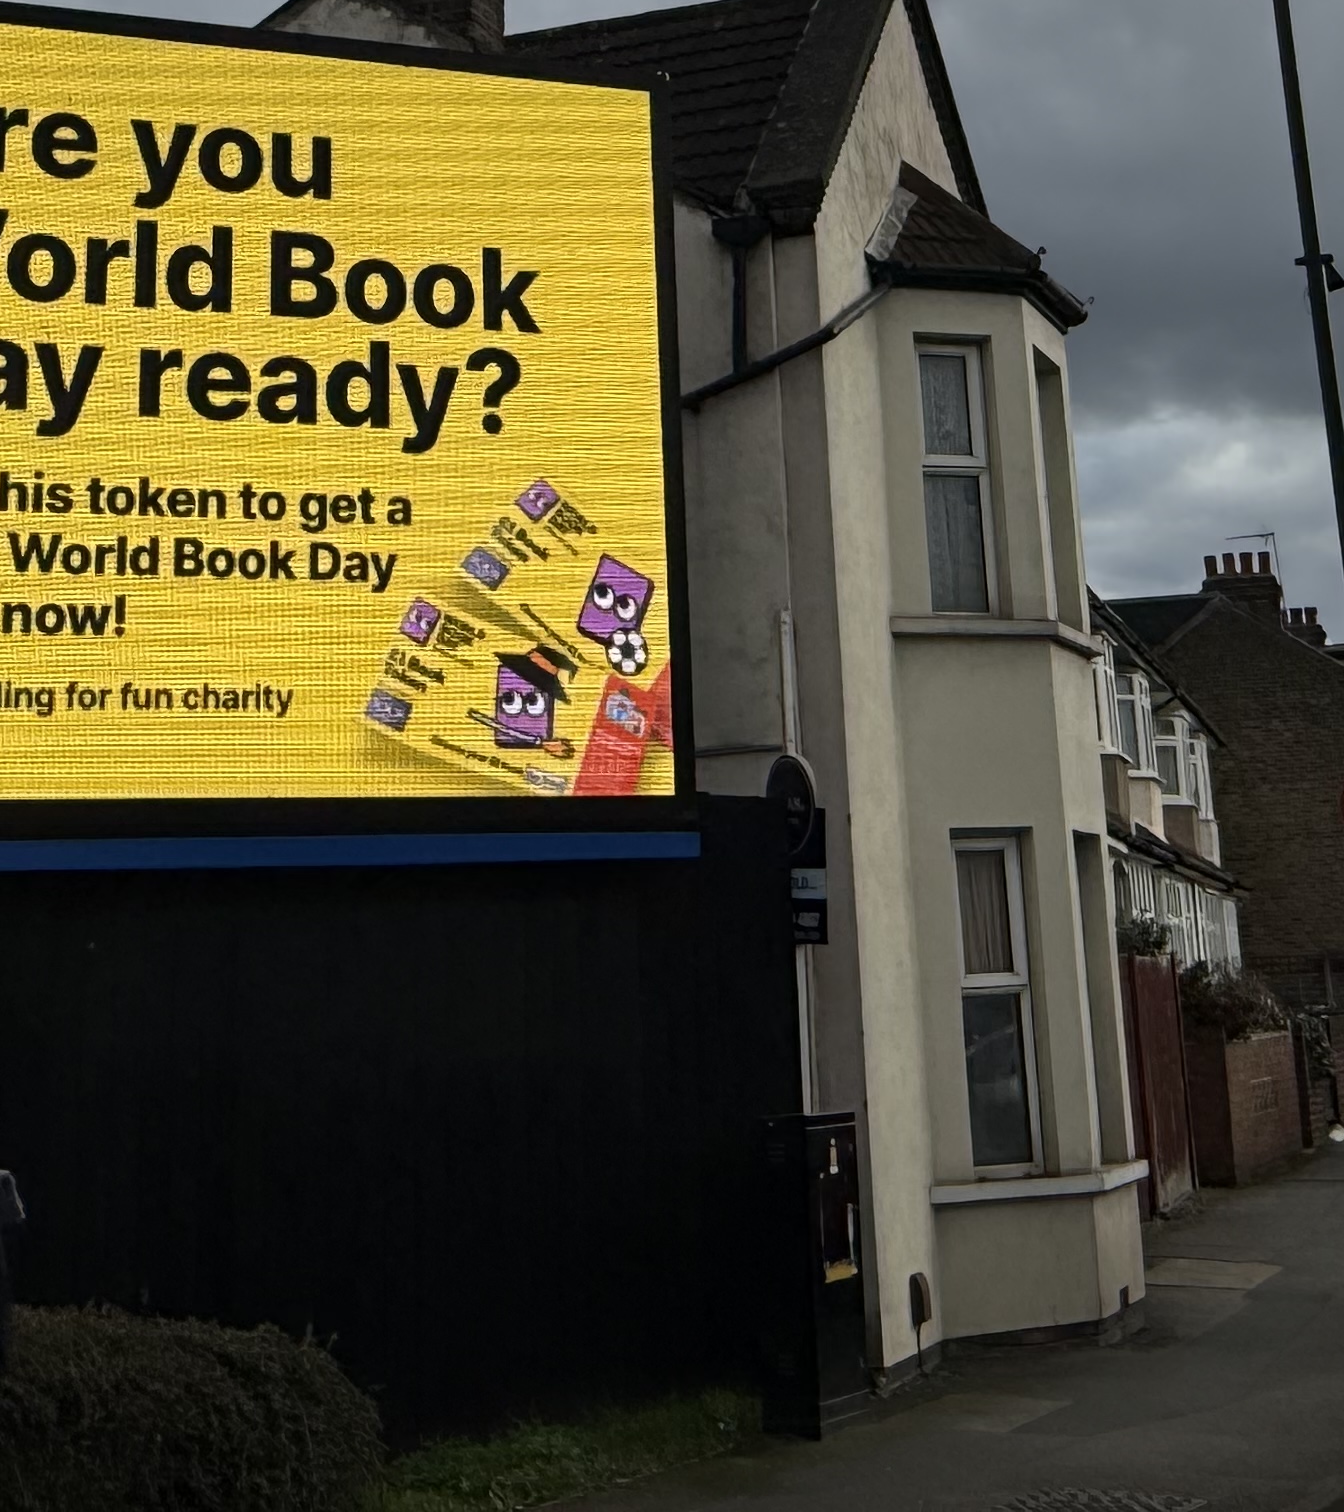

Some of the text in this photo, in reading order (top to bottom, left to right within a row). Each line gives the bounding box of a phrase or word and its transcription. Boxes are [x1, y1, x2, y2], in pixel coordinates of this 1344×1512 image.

[131, 119, 332, 209] you
[270, 230, 542, 334] Book
[139, 341, 522, 454] ready?
[86, 477, 226, 519] token
[239, 483, 287, 520] to
[300, 488, 375, 534] get
[387, 497, 412, 525] a
[8, 532, 159, 576] World
[174, 538, 297, 580] Book
[309, 542, 397, 593] Day
[2, 595, 126, 637] now!
[66, 682, 112, 711] for
[121, 683, 174, 711] fun
[182, 683, 293, 717] charity
